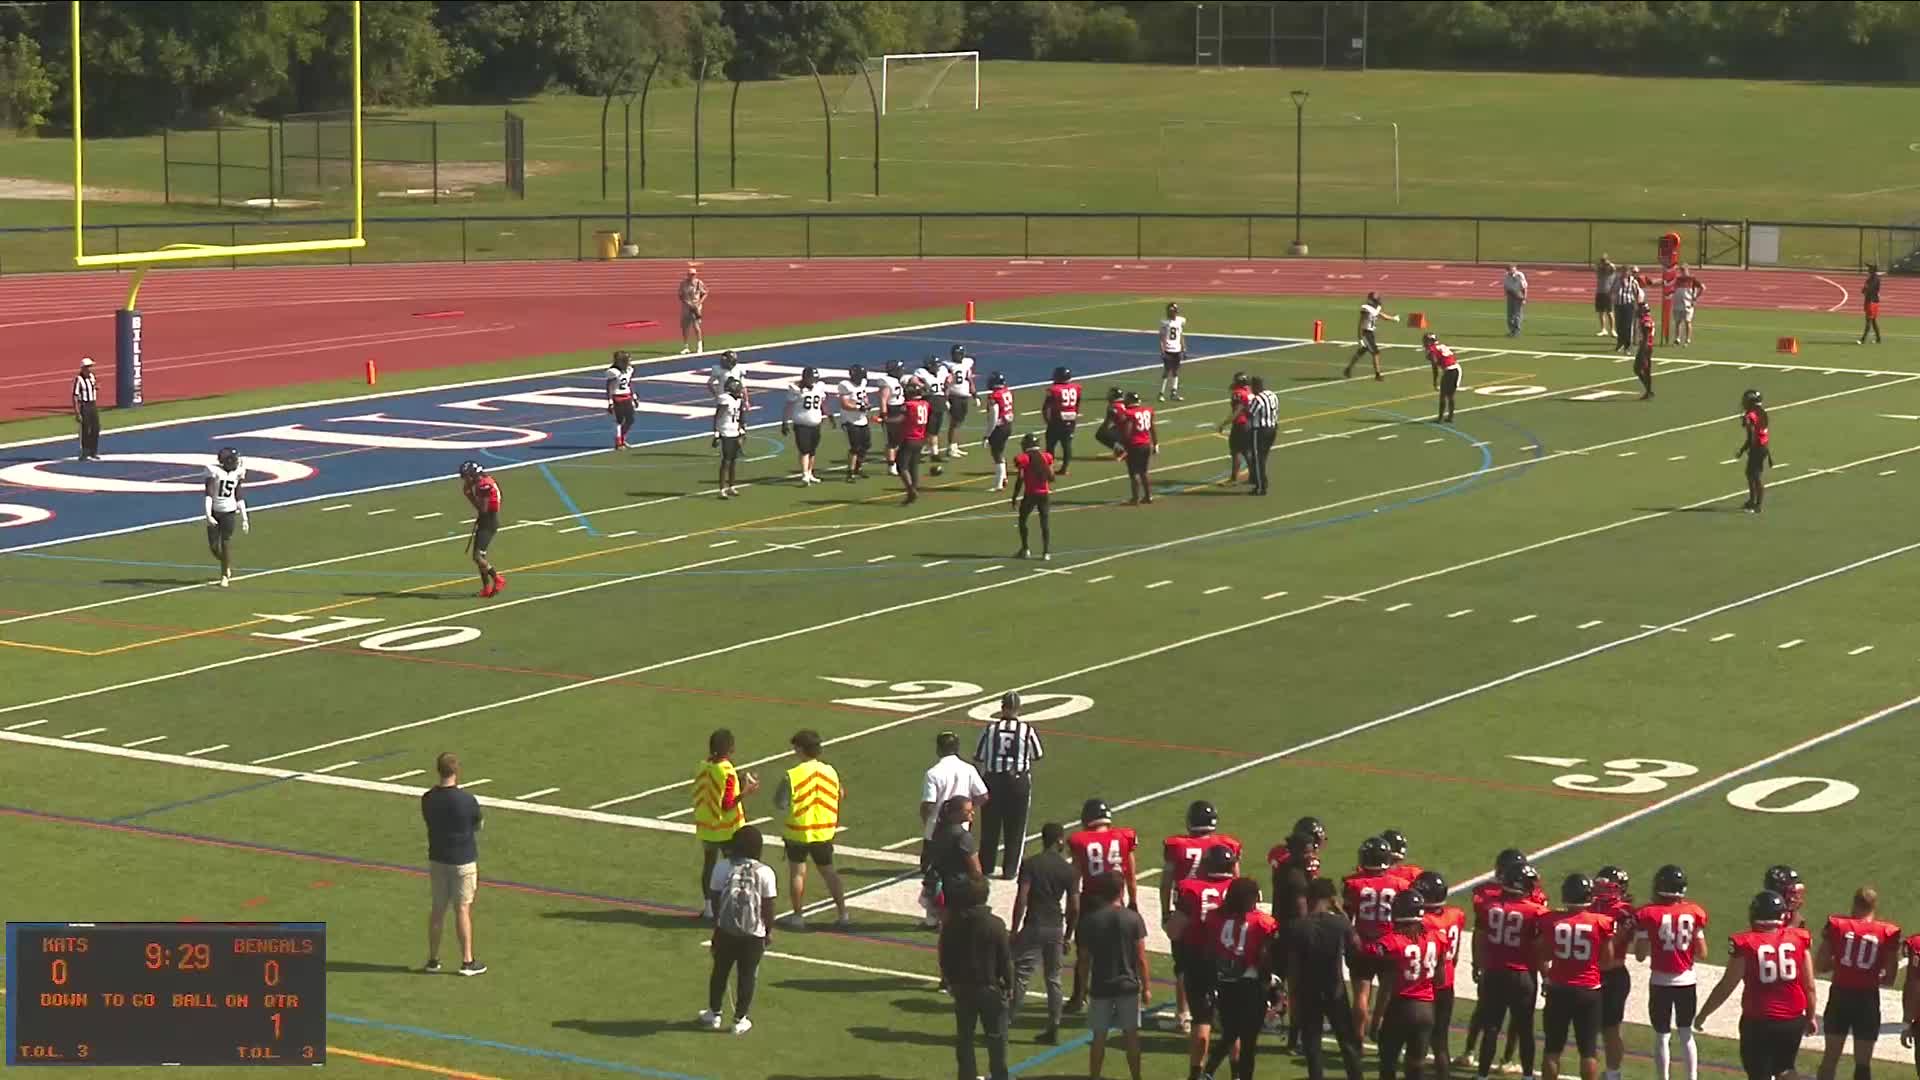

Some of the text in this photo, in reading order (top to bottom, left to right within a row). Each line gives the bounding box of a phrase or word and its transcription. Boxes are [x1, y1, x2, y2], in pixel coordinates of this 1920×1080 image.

[131, 317, 142, 403] BILLIES
[1061, 388, 1077, 407] 99
[218, 479, 237, 498] 15
[1086, 839, 1122, 876] 84
[1487, 907, 1523, 947] 92
[1554, 922, 1594, 961] 95
[1658, 914, 1695, 951] 48
[1404, 941, 1437, 980] 34
[1757, 942, 1797, 984] 66
[1840, 931, 1880, 970] 10
